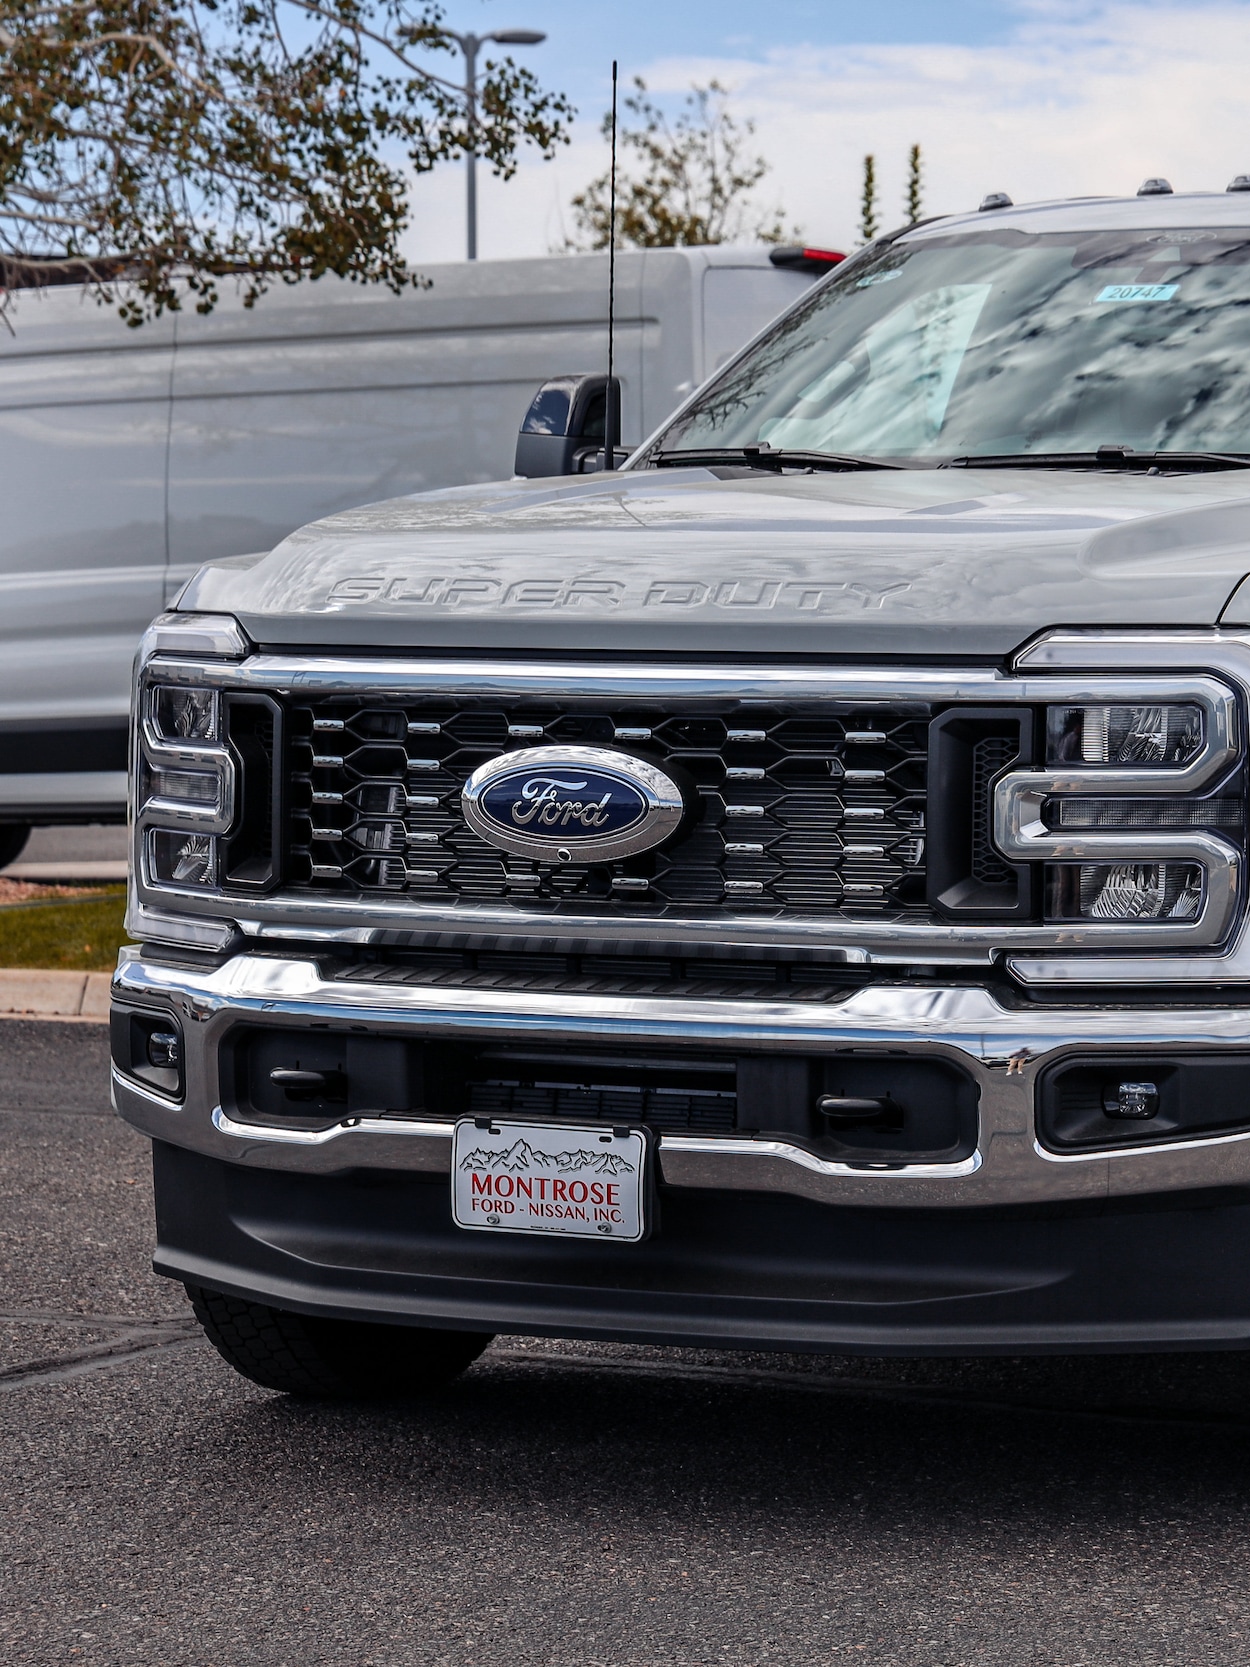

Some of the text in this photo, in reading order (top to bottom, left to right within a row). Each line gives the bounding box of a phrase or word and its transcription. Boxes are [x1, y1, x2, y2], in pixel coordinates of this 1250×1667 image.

[1107, 286, 1167, 299] 20747
[325, 577, 912, 610] SUPER DUTY
[511, 777, 614, 827] Ford
[471, 1172, 621, 1206] MONTROSE
[472, 1197, 515, 1215] FORD
[529, 1202, 590, 1224] NISSAN,
[594, 1207, 626, 1224] INC.
